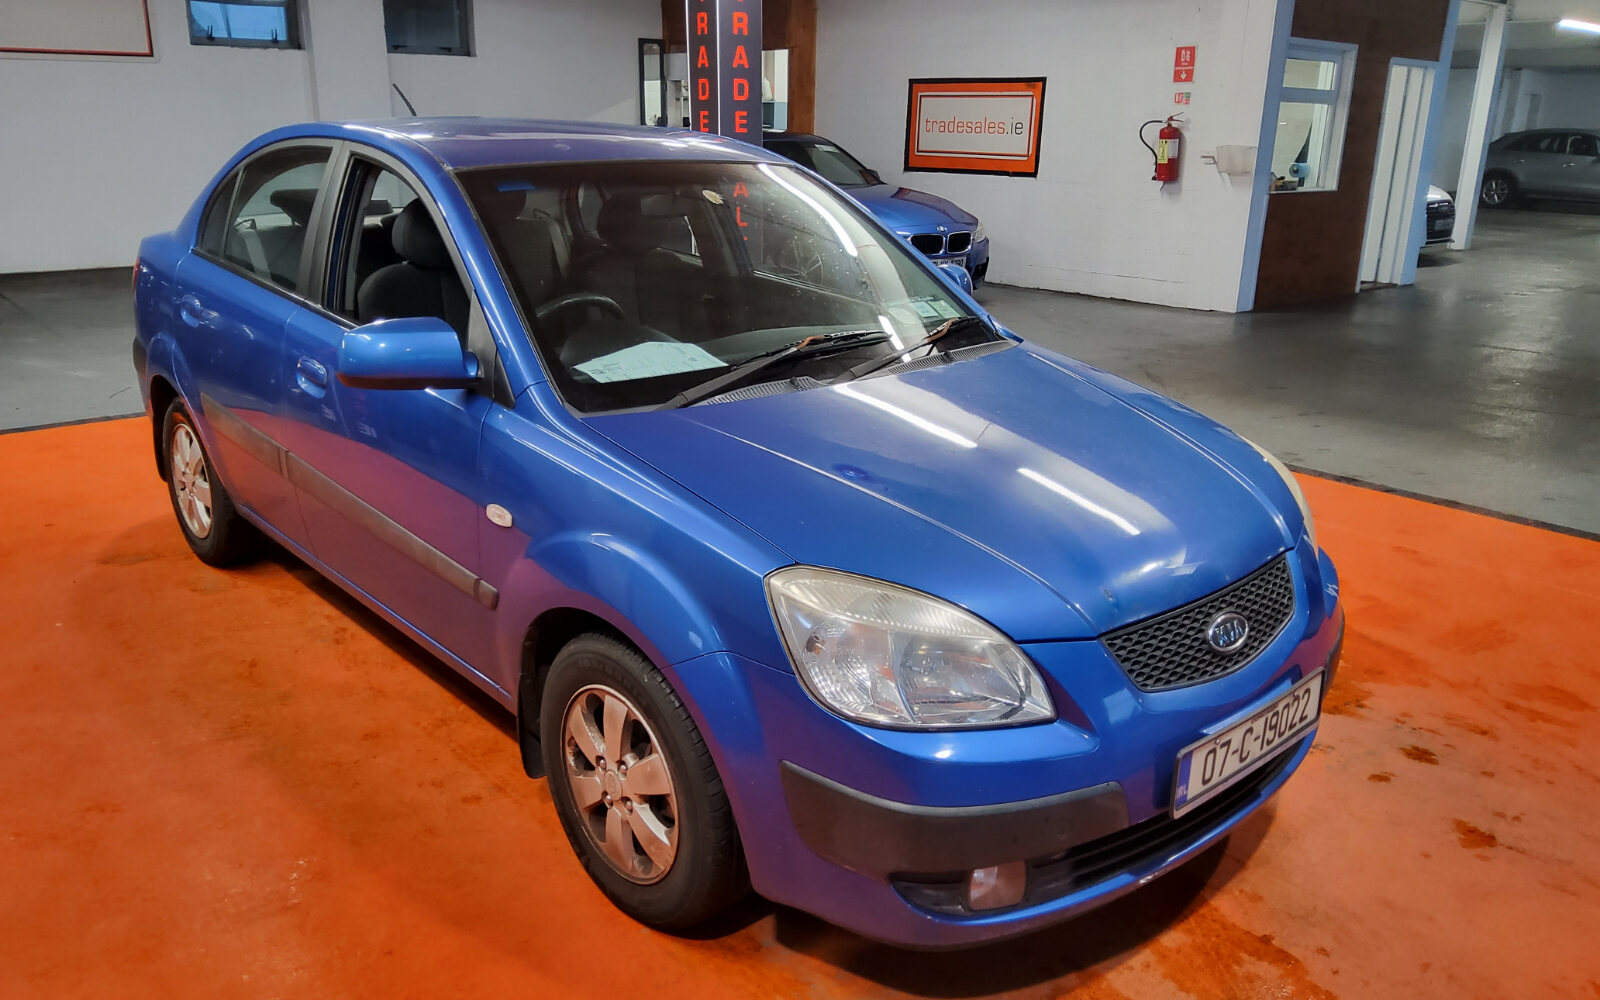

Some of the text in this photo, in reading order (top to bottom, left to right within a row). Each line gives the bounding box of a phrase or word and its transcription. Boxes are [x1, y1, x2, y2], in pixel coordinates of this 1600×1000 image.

[697, 0, 709, 132] RADE
[732, 0, 749, 133] RADE
[925, 116, 1023, 135] tradesales.ie
[1213, 619, 1244, 647] KIA
[1201, 687, 1311, 786] 07-C-19022
